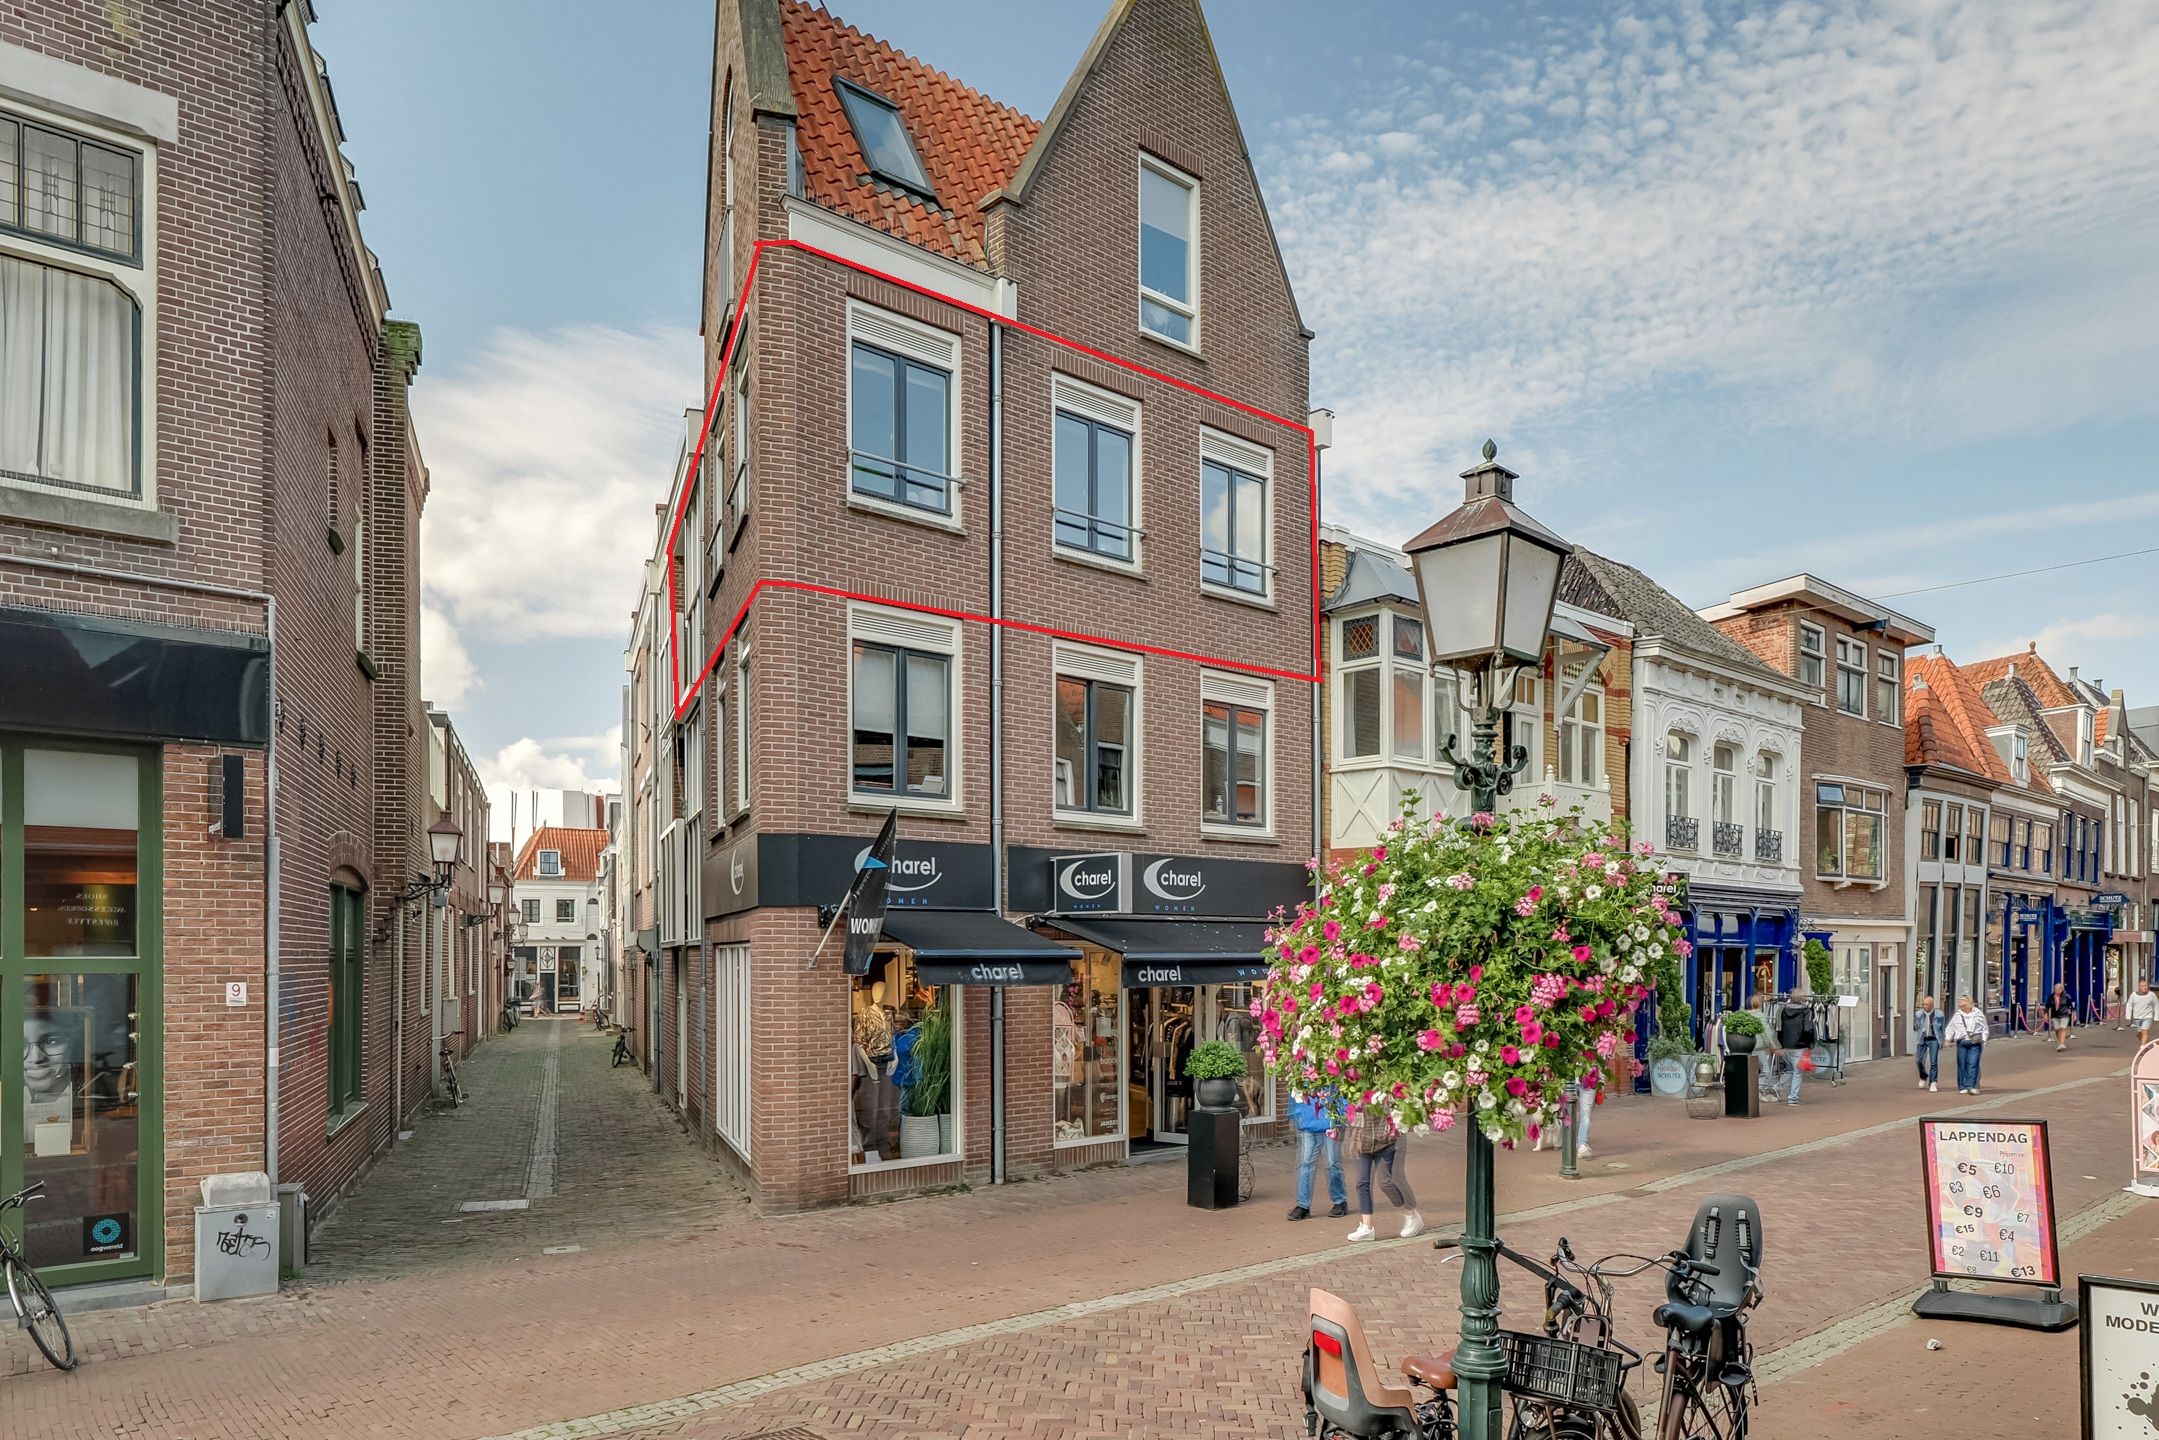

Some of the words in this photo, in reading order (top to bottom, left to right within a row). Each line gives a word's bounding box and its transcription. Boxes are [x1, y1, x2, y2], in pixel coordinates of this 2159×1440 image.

[891, 856, 936, 876] harel
[1074, 869, 1112, 887] charel
[1160, 869, 1202, 888] charel
[886, 897, 928, 905] OMEN
[1155, 904, 1195, 912] WOMEN
[970, 962, 1025, 980] charel
[1137, 965, 1182, 982] charel
[232, 984, 241, 997] 9
[1940, 1131, 2028, 1144] LAPPENDAG
[1957, 1163, 1978, 1176] €5
[1994, 1163, 2015, 1175] €10
[1949, 1181, 1964, 1194] €3
[1983, 1185, 2001, 1199] €6
[1963, 1205, 1984, 1218] €9
[2017, 1212, 2030, 1224] €7
[1956, 1224, 1975, 1234] €15
[1999, 1228, 2015, 1242] €4
[90, 1243, 124, 1252] oogwereld
[1952, 1245, 1965, 1257] €2
[1980, 1250, 2000, 1262] €11
[2011, 1265, 2036, 1278] €13
